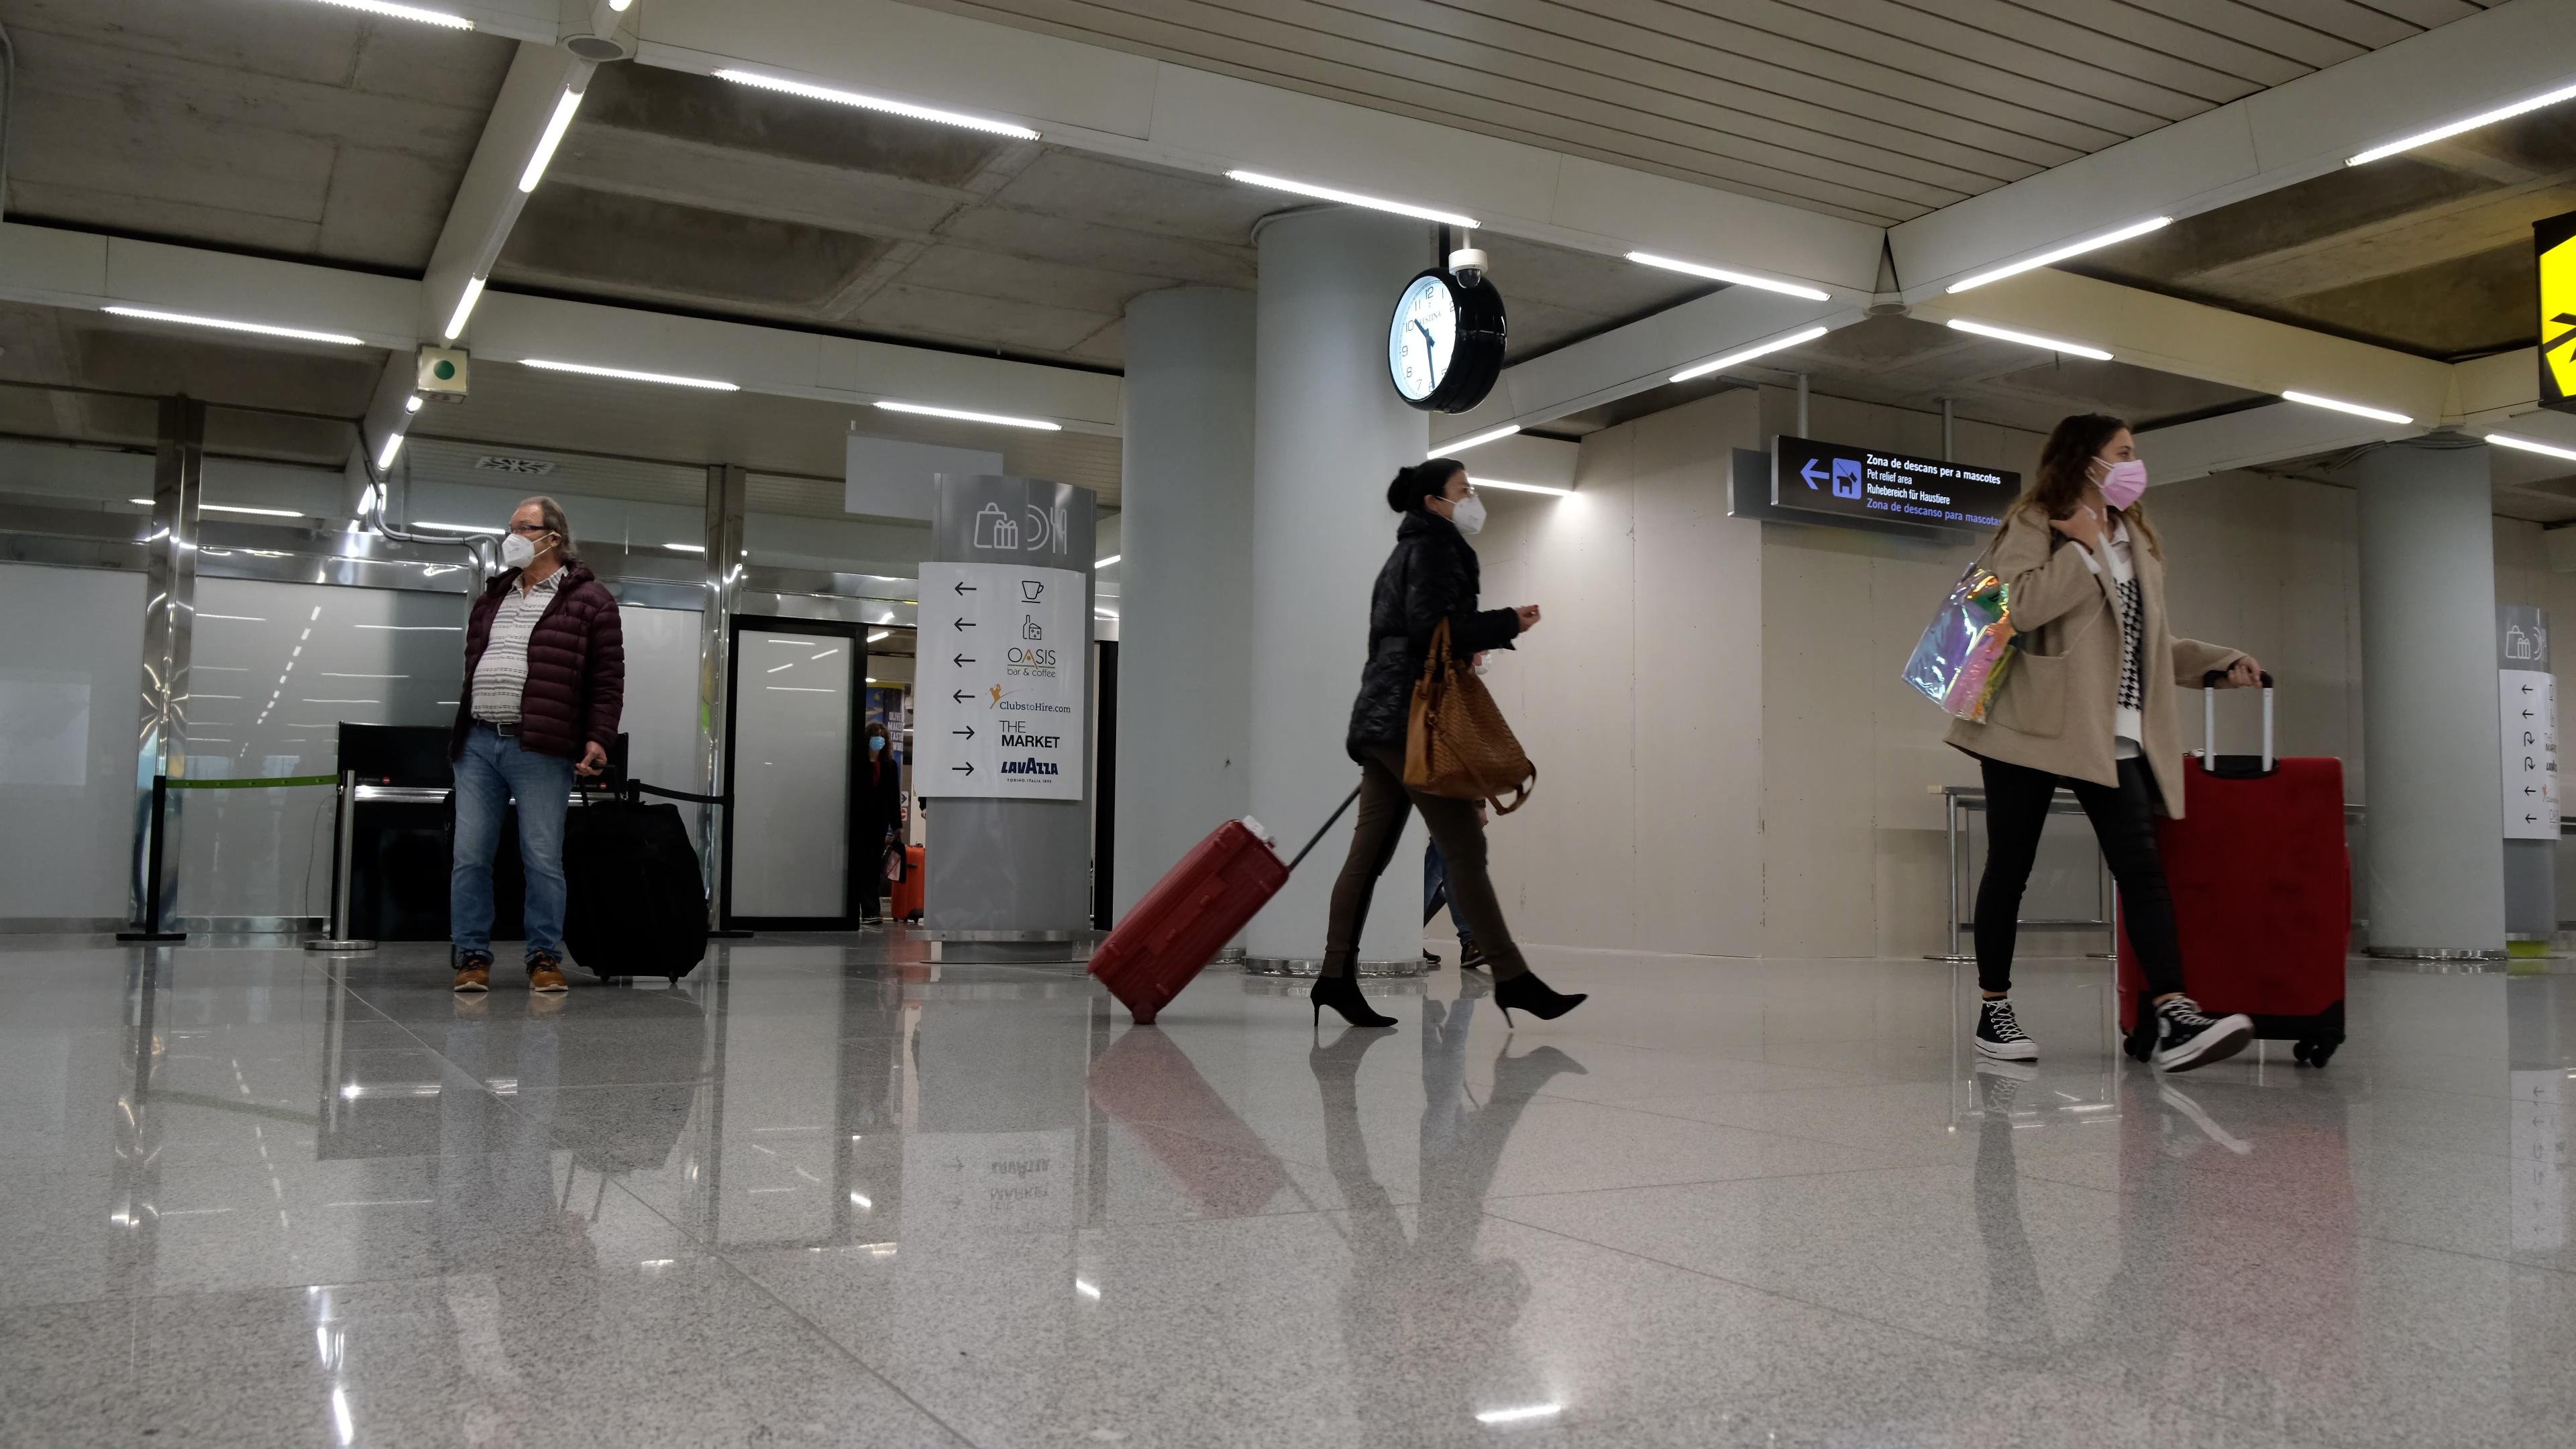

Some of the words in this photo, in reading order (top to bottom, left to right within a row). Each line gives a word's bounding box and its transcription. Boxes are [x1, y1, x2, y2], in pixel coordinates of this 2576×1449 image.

[1426, 286, 1434, 299] 12
[1415, 299, 1421, 311] 11
[1405, 320, 1414, 333] 10
[1401, 345, 1408, 357] 9
[1406, 366, 1413, 378] 8
[1416, 378, 1422, 391] 7
[1866, 453, 1888, 467] Zona
[1890, 458, 1902, 469] de
[1904, 460, 1938, 474] descans
[1939, 468, 1953, 478] per
[1955, 470, 1961, 478] a
[1963, 472, 2001, 484] mascotes
[1867, 469, 1878, 480] Pet
[1879, 472, 1896, 482] relief
[1897, 476, 1913, 484] area
[1867, 483, 1907, 498] Ruhebereich
[1909, 489, 1919, 500] für
[1920, 490, 1950, 504] Haustiere
[1867, 498, 1888, 510] Zona
[1891, 502, 1902, 511] de
[1904, 503, 1942, 517] descanso
[1945, 511, 1963, 521] para
[1008, 647, 1056, 669] OASIS
[1007, 667, 1020, 676] bar
[1032, 669, 1056, 678] coffee
[1000, 701, 1071, 713] ClubstoHire.com
[999, 720, 1026, 733] THE
[1001, 735, 1061, 749] MARKET
[1001, 757, 1059, 775] LAVAZZA
